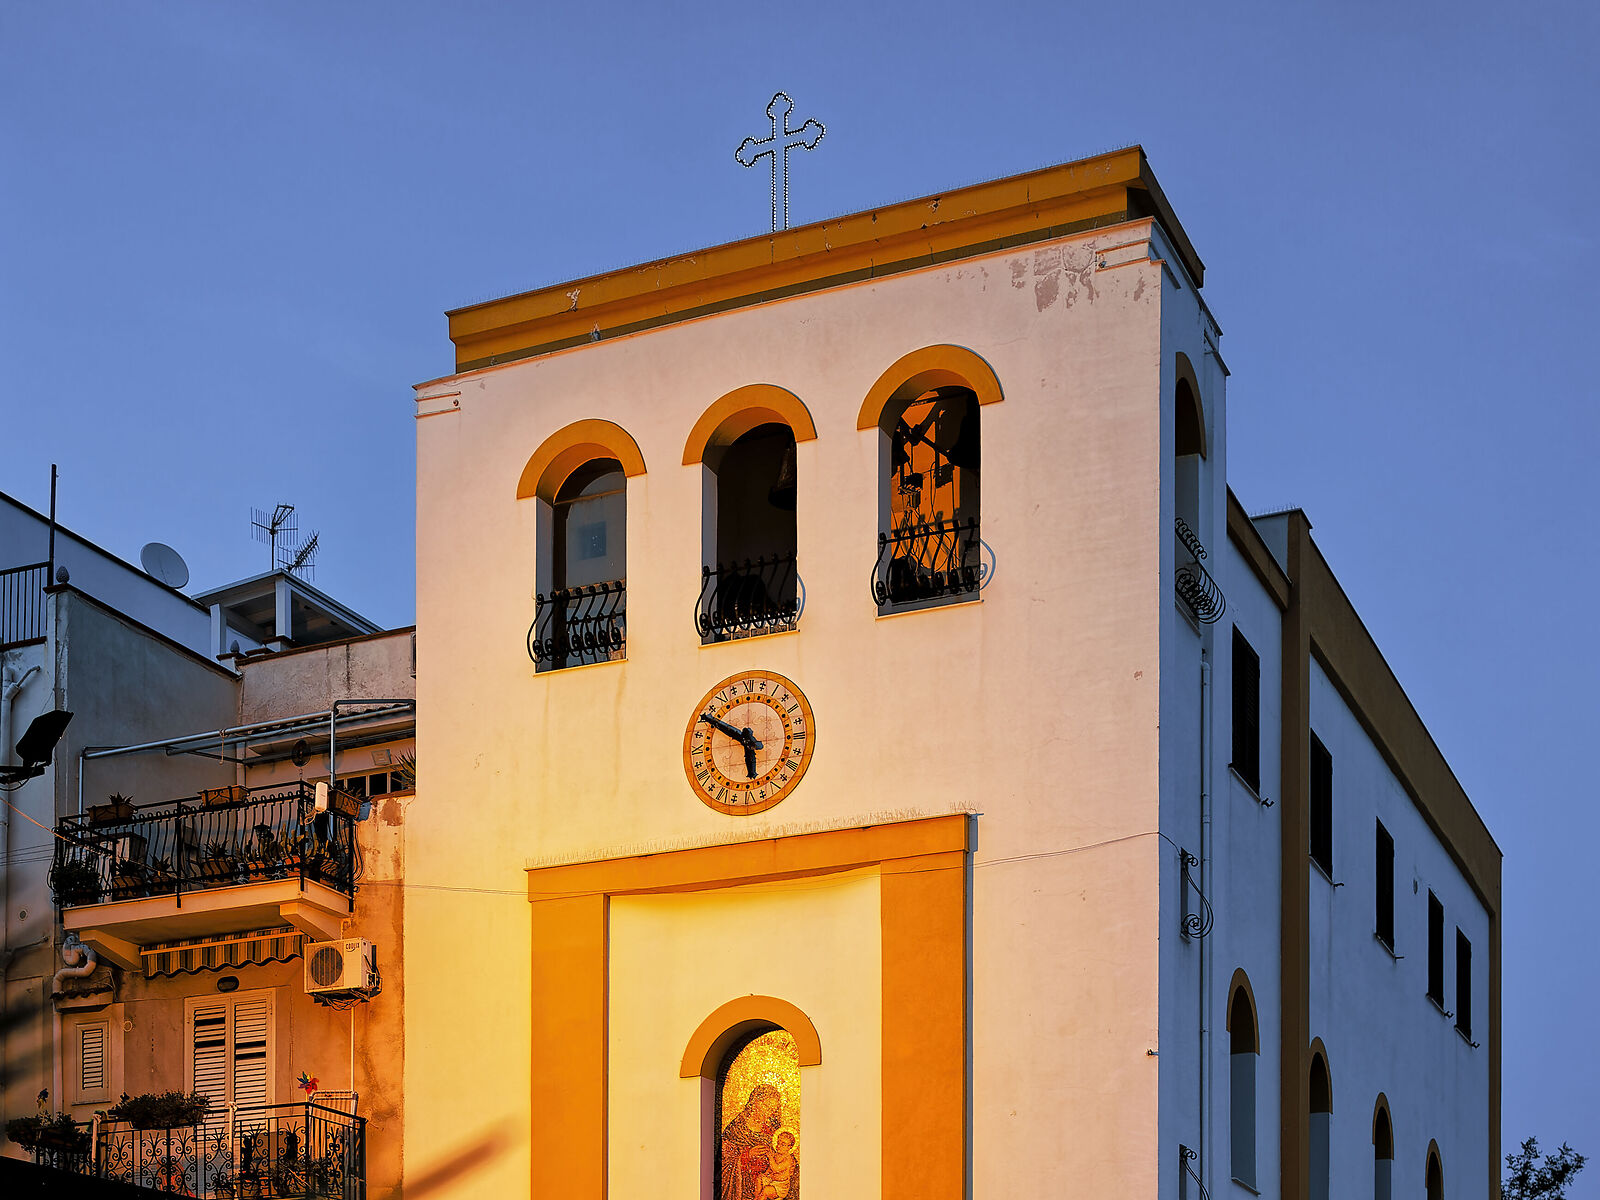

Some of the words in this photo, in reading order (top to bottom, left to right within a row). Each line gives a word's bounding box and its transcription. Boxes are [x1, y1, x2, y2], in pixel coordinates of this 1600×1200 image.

[743, 679, 754, 692] XII
[787, 703, 799, 714] II
[793, 731, 806, 740] III
[744, 791, 757, 805] VI
